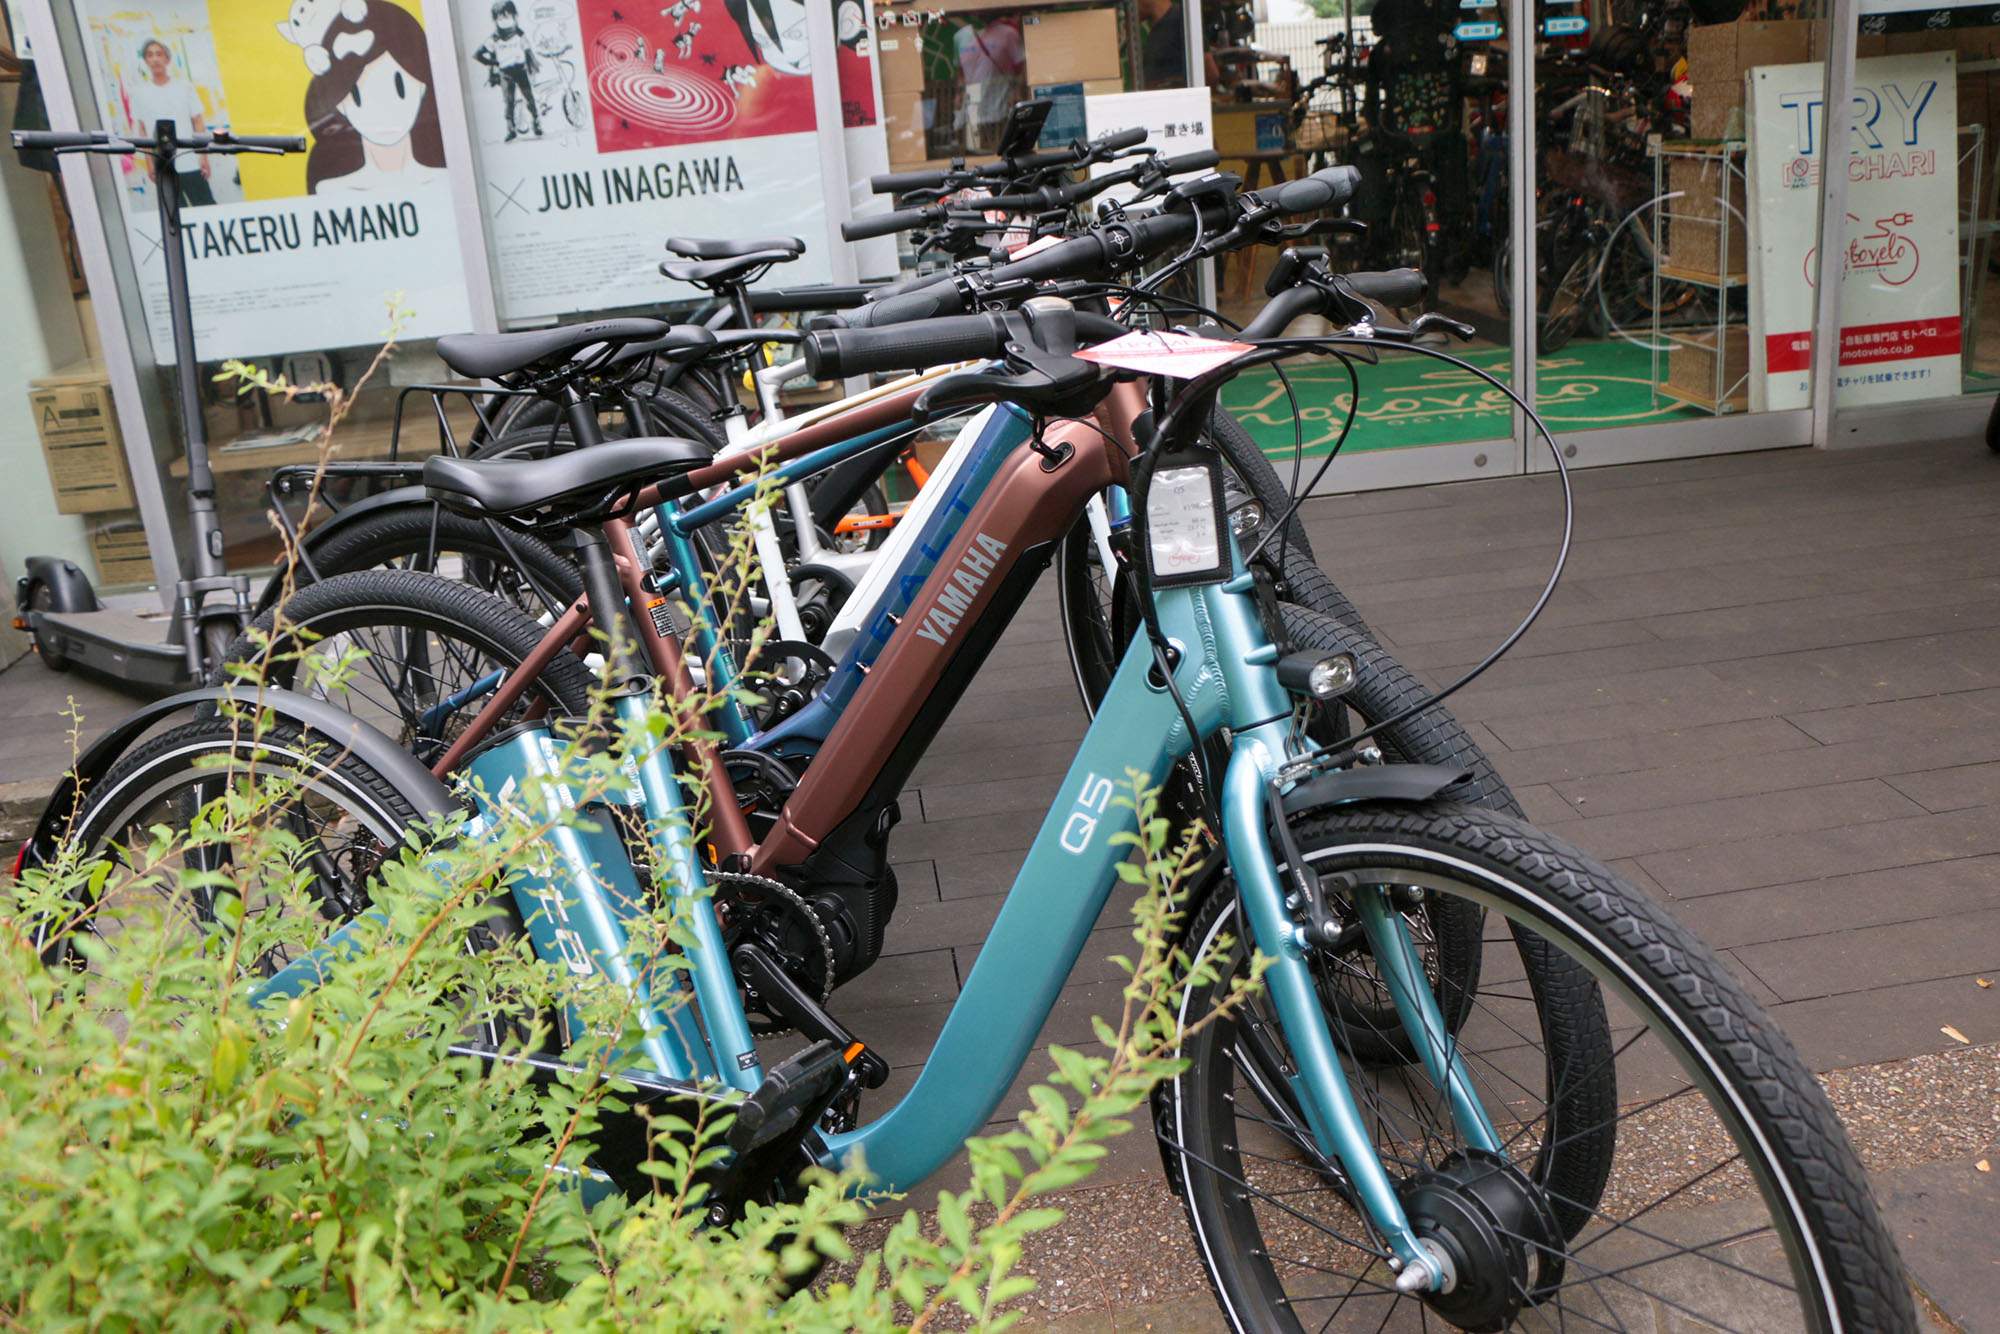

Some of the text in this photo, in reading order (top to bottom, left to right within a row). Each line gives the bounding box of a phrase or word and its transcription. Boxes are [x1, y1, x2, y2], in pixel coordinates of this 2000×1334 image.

[1780, 80, 1937, 154] TRY
[538, 155, 744, 212] JUN INAGAWA
[181, 201, 419, 260] TAKERU AMANO
[1841, 344, 1915, 359] .motovelo.co.jp
[916, 532, 1009, 647] YAMAHA
[1060, 772, 1113, 854] Q5
